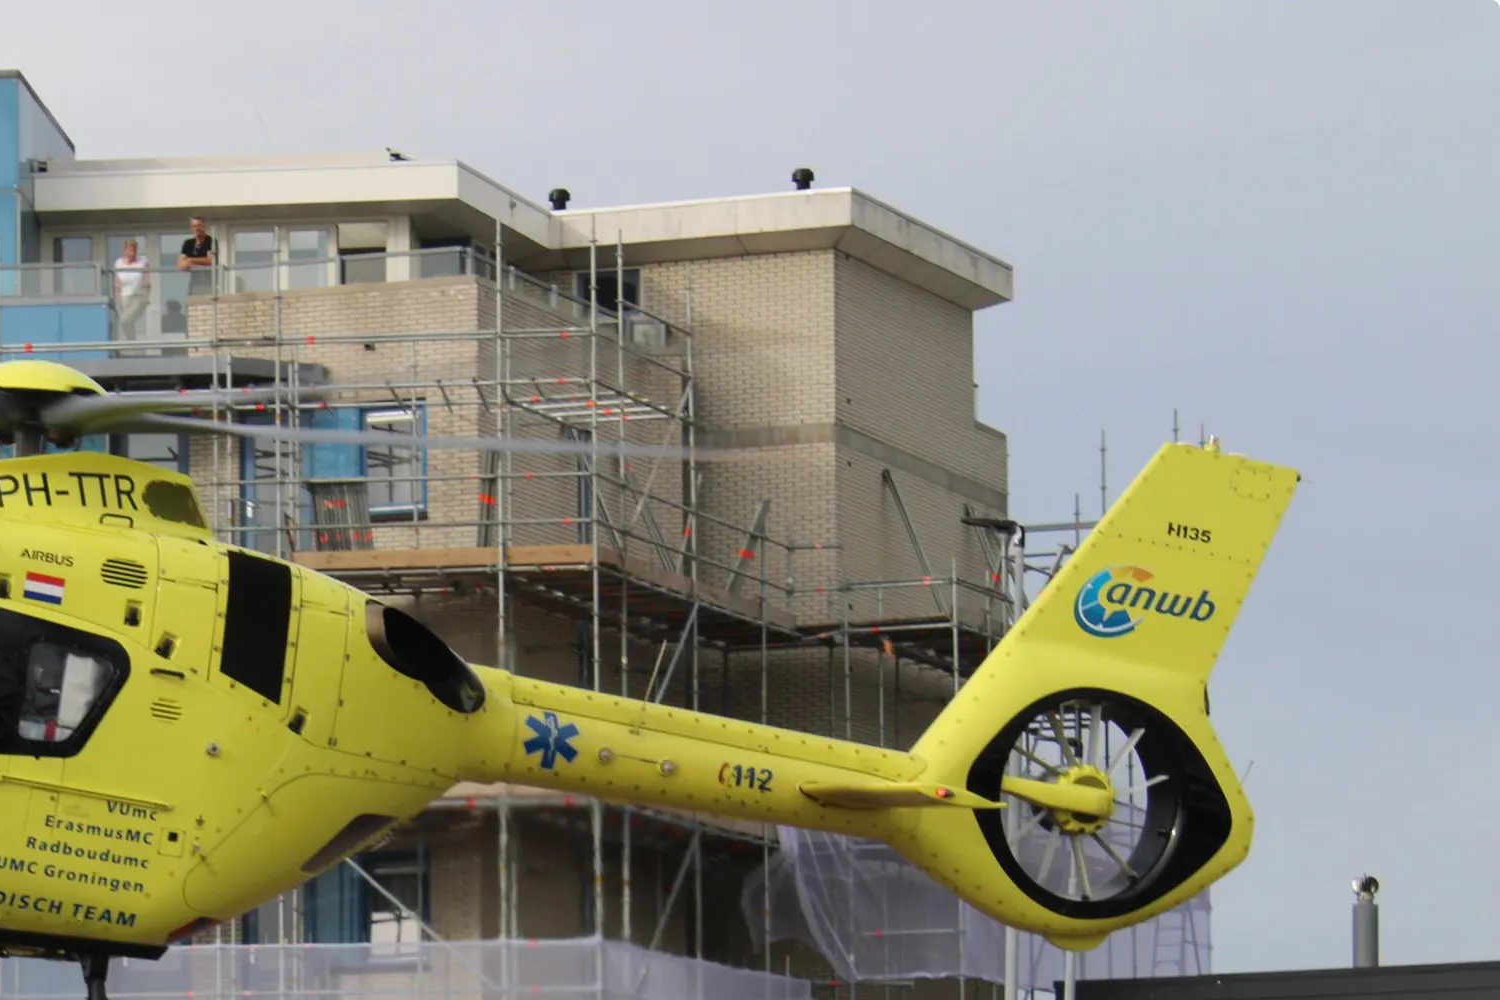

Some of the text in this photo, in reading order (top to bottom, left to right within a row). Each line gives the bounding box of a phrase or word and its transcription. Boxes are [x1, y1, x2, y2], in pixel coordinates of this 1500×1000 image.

[1167, 522, 1212, 544] H135
[20, 548, 74, 568] AIRBUS
[1106, 582, 1216, 622] anwb
[732, 764, 774, 792] 112
[106, 800, 158, 822] VUmc
[44, 815, 154, 845] ErasmusMC
[26, 836, 150, 869] Radboudumc
[44, 864, 145, 893] Groningen
[71, 903, 138, 928] TEAM
